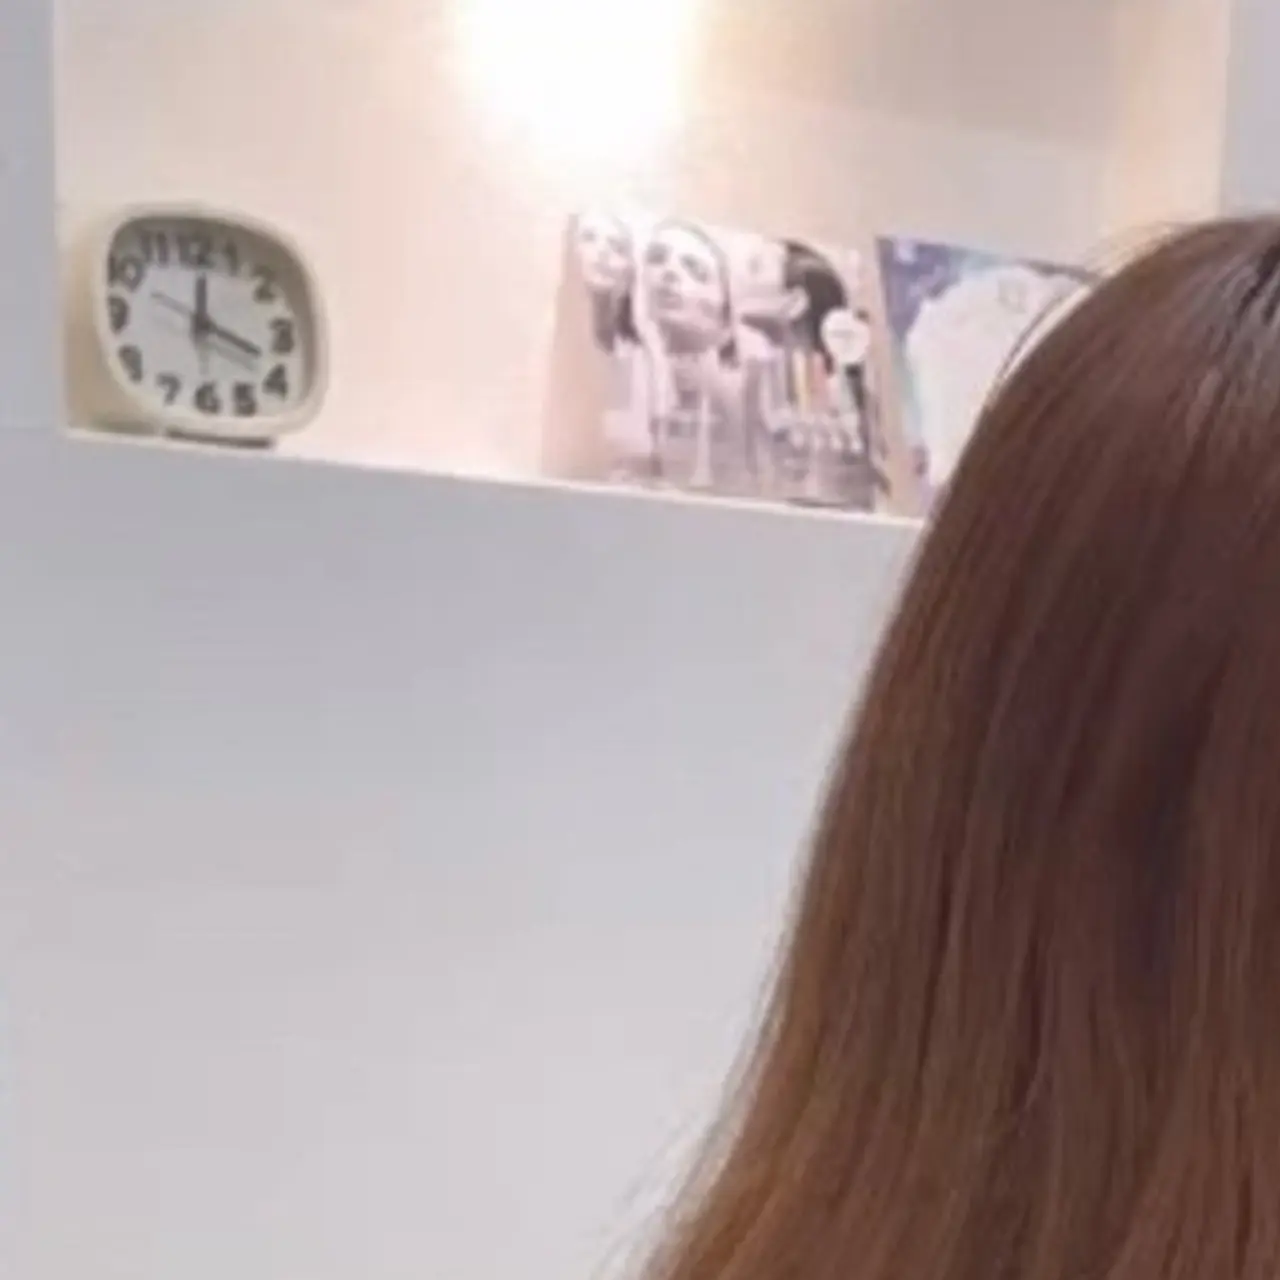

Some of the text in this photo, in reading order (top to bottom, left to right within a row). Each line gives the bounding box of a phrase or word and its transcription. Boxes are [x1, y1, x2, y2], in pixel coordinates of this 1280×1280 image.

[156, 373, 182, 405] 7
[193, 380, 221, 415] 6
[263, 363, 289, 401] 4
